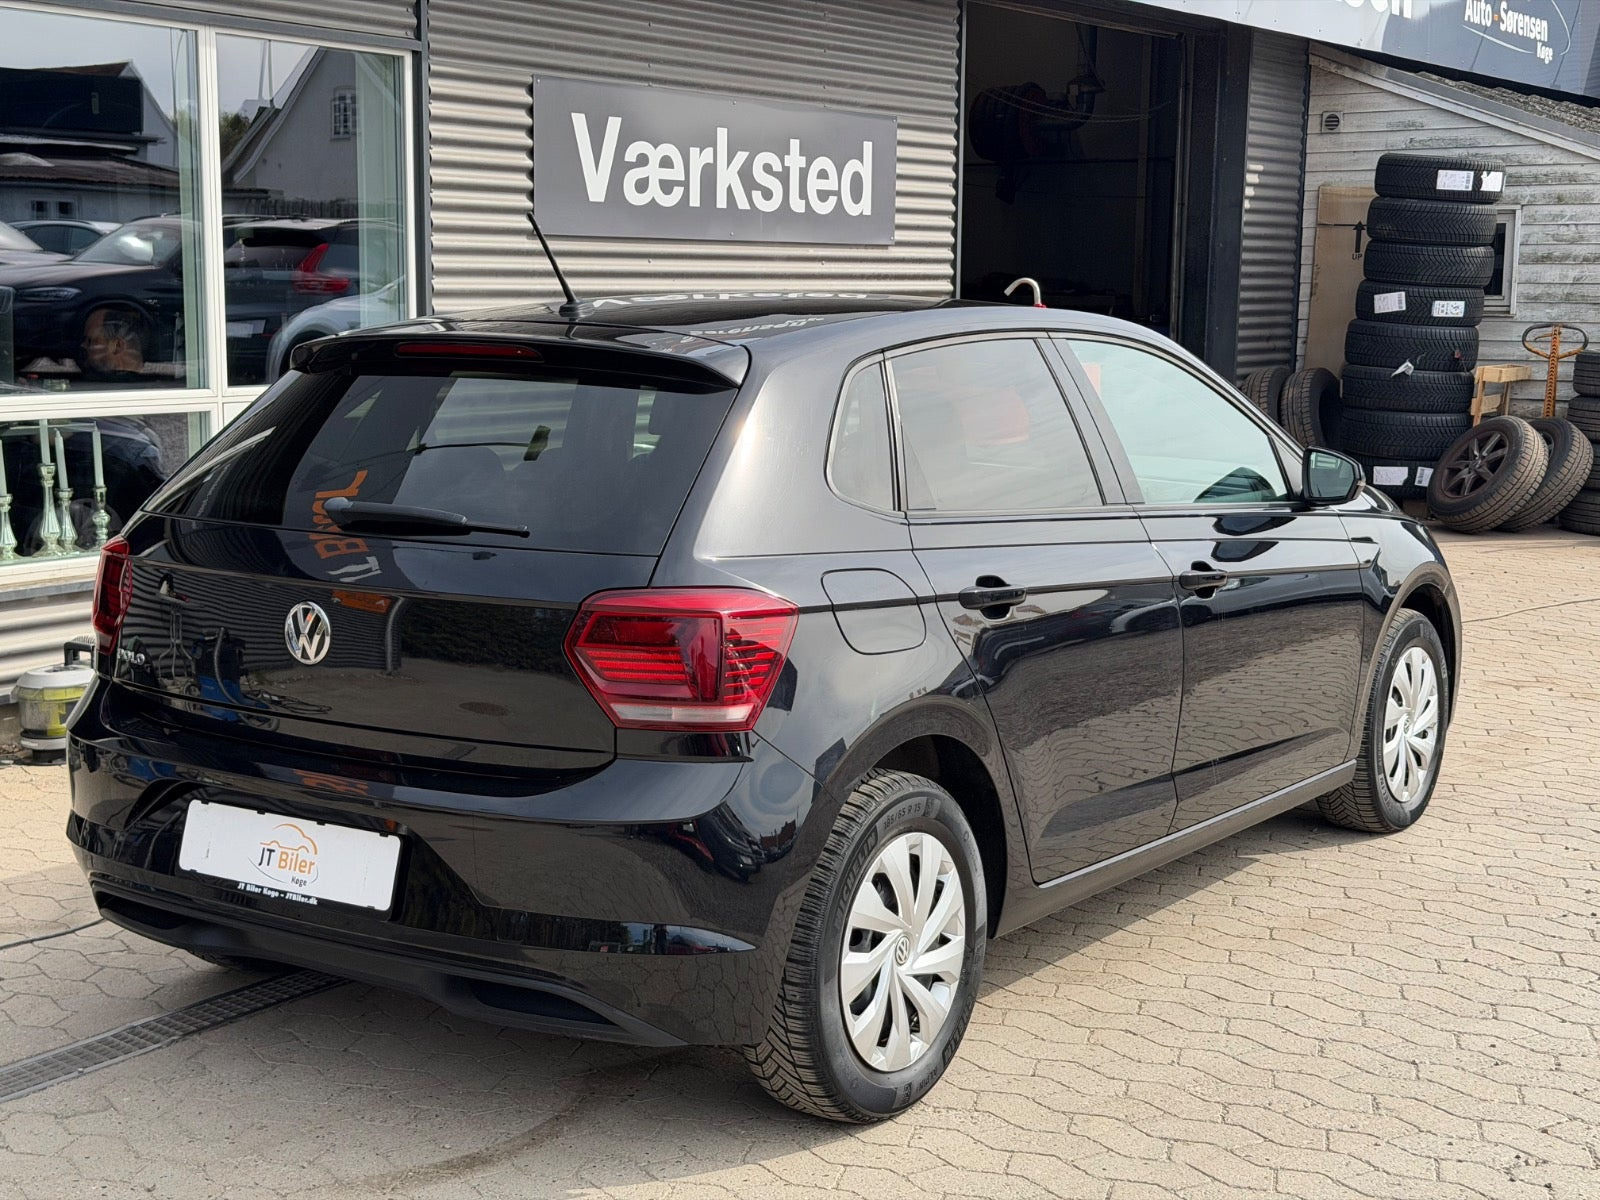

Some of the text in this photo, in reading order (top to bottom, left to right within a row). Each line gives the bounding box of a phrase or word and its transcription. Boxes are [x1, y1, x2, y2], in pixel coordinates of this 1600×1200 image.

[571, 112, 873, 217] Værksted
[258, 846, 315, 874] JT Biler
[246, 883, 262, 894] Biler
